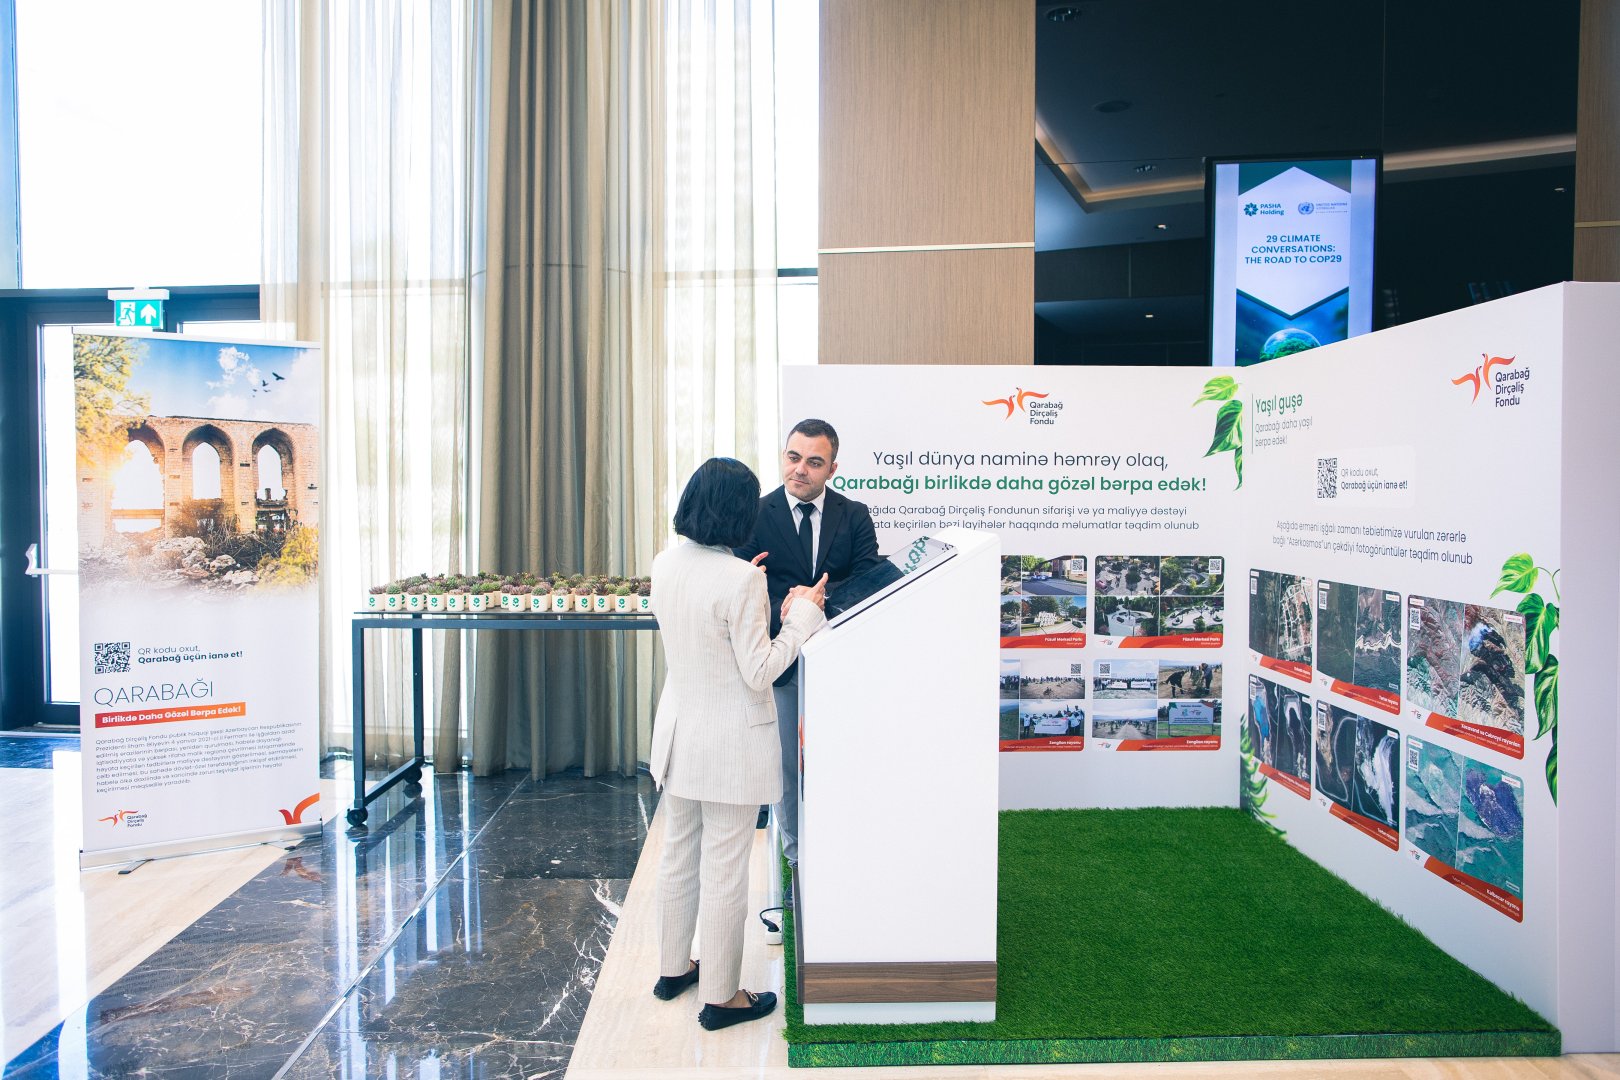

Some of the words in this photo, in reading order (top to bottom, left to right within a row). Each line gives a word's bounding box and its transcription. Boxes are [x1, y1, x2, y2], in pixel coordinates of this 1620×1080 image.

[1280, 234, 1320, 242] CLIMATE
[1251, 245, 1335, 254] CONVERSATIONS:
[1245, 256, 1262, 264] THE
[1264, 256, 1291, 264] ROAD
[1309, 255, 1342, 263] COP29
[1495, 367, 1530, 382] Qarabağ
[1496, 381, 1524, 395] Dirçəliş
[1030, 401, 1063, 410] Qarabağ
[1256, 394, 1277, 416] Yaşıl
[1279, 394, 1302, 415] guşə
[1495, 395, 1520, 407] Fondu
[1030, 409, 1058, 418] Dirçəliş
[873, 451, 913, 470] Yaşıl
[919, 451, 975, 470] dünya
[980, 451, 1048, 466] naminə
[1054, 452, 1121, 470] həmrəy
[1126, 453, 1168, 471] olaq,
[832, 475, 919, 494] Qarabağı
[925, 475, 992, 490] birlikdə
[996, 476, 1043, 490] daha
[1049, 476, 1095, 495] gözəl
[1100, 477, 1153, 495] bərpa
[1158, 477, 1206, 491] edək!
[1341, 480, 1366, 492] Qarabağ
[1368, 480, 1382, 492] üçün
[1384, 480, 1397, 490] ianə
[1399, 480, 1408, 490] et!
[899, 505, 946, 517] Qarabağ
[948, 505, 985, 517] Dirçəliş
[988, 506, 1039, 515] Fondunun
[1042, 506, 1074, 517] sifarişi
[1092, 508, 1105, 517] ya
[1108, 506, 1148, 517] maliyyə
[1150, 506, 1187, 517] dəstəyi
[894, 520, 936, 531] keçirilən
[962, 520, 1006, 531] layihələr
[1009, 520, 1059, 531] haqqında
[1062, 521, 1122, 530] məlumatlar
[1125, 521, 1161, 532] təqdim
[1164, 521, 1199, 530] olunub
[1404, 528, 1435, 540] vurulan
[1437, 530, 1466, 543] zərərlə
[1409, 548, 1439, 563] təqdim
[1441, 551, 1473, 564] olunub
[138, 647, 151, 655] QR
[154, 646, 177, 654] kodu
[180, 645, 200, 653] oxut,
[138, 655, 181, 664] Qarabağ
[183, 654, 206, 663] üçün
[209, 652, 229, 660] ianə
[94, 677, 213, 708] QARABAĞI
[139, 712, 163, 721] Daha
[164, 709, 189, 719] Gözəl
